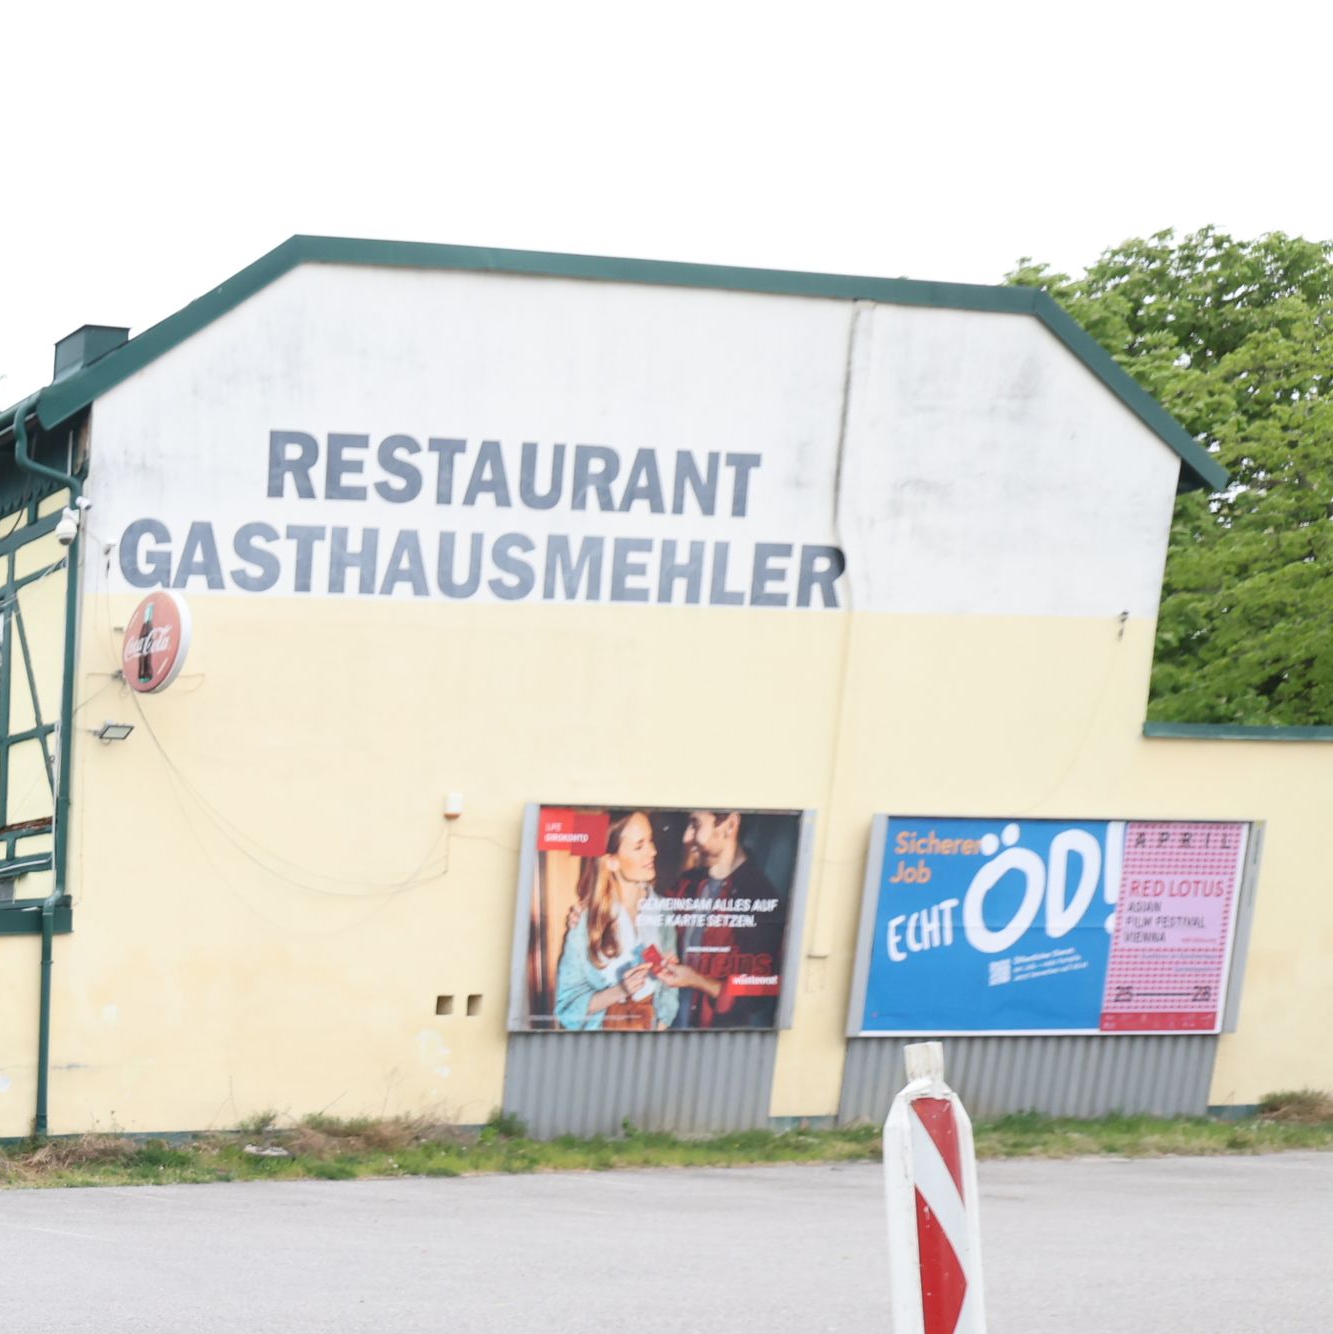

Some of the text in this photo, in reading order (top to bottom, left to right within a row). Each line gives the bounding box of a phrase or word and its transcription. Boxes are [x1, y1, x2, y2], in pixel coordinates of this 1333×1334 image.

[267, 429, 762, 519] RESTAURANT
[889, 859, 932, 884] Job
[886, 820, 1127, 962] ECHT ÖD!
[1130, 880, 1225, 897] RED LOTUS
[638, 897, 779, 912] GEMEINSAM ALLES AUF
[1127, 902, 1162, 912] ASIAN
[635, 913, 758, 928] EINE KARTE SETZEN.
[1125, 916, 1205, 929] FILM FESTIVAL
[1123, 932, 1167, 943] VIENNA
